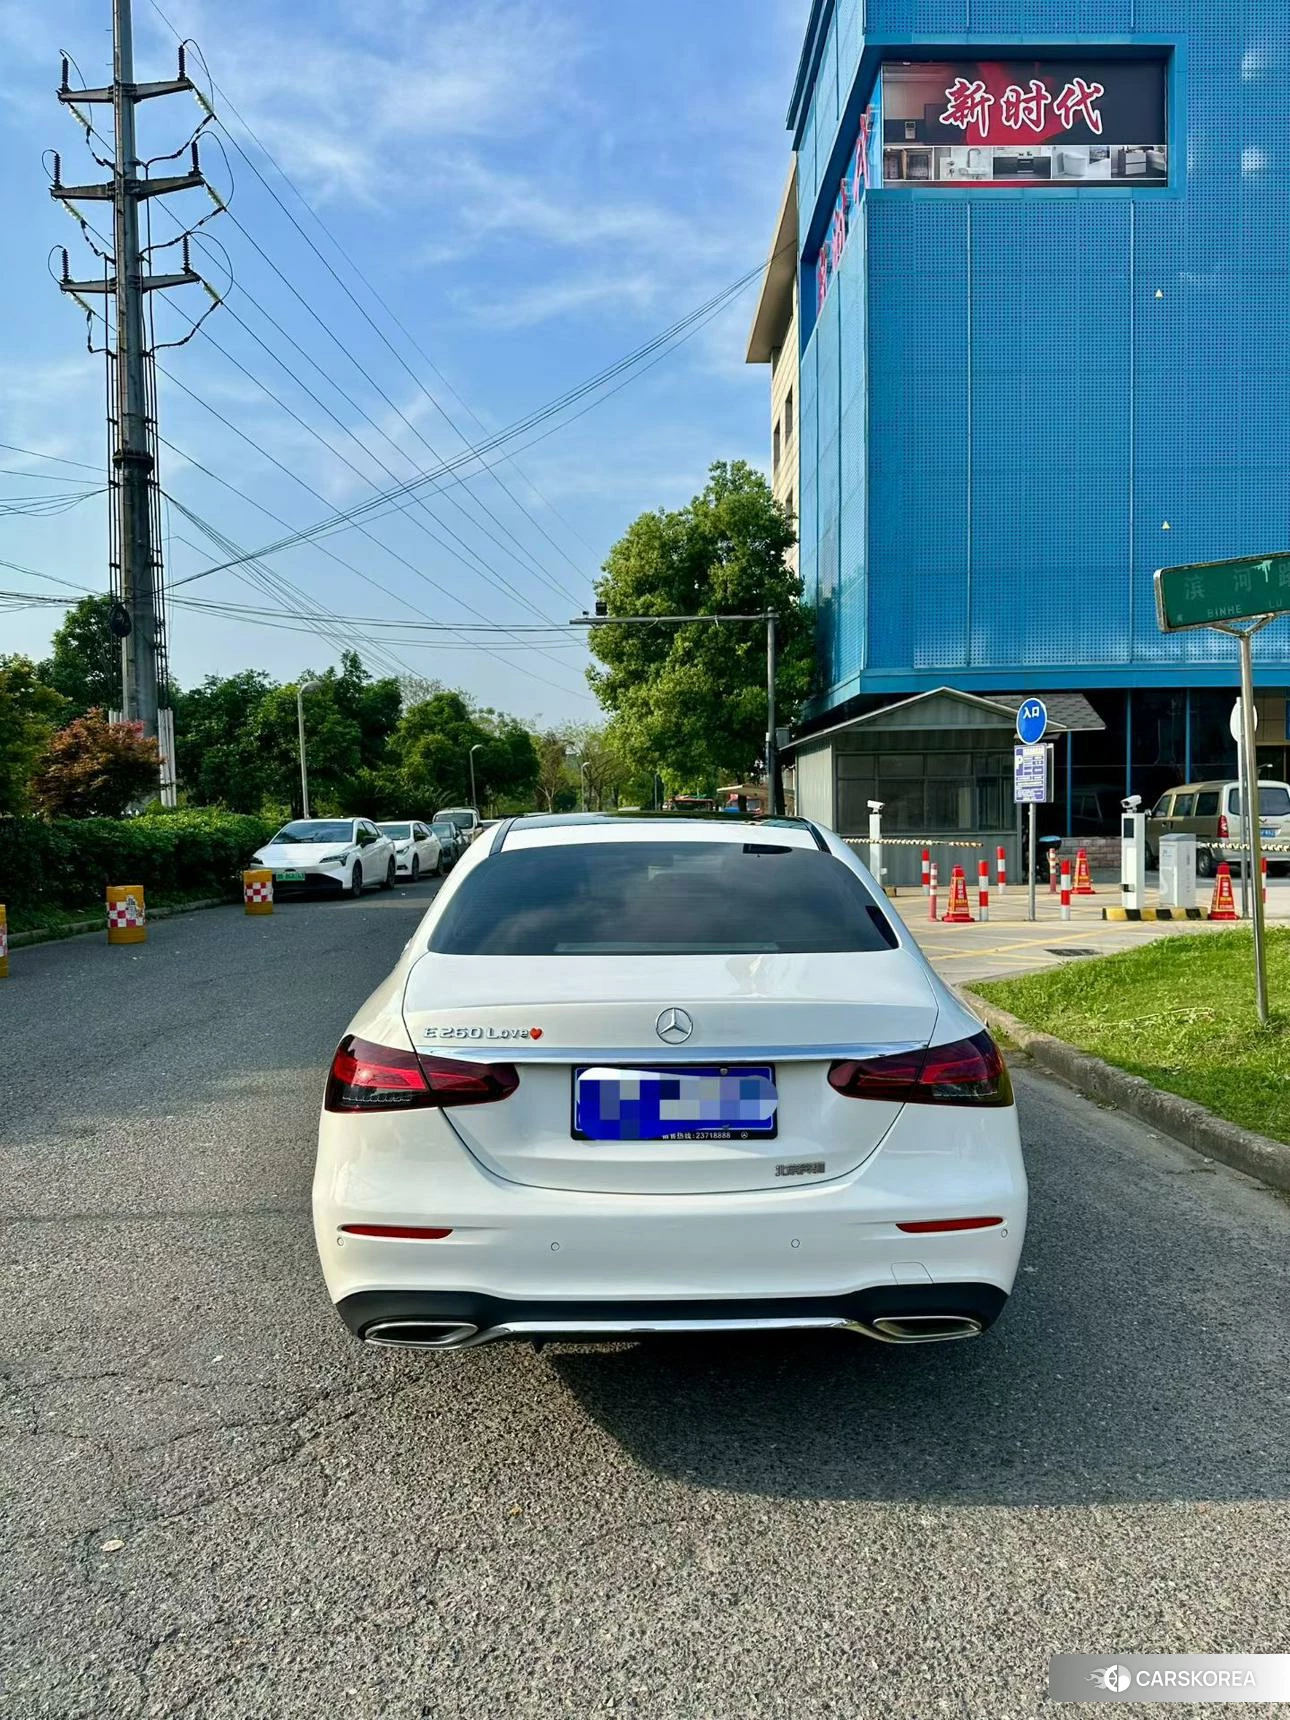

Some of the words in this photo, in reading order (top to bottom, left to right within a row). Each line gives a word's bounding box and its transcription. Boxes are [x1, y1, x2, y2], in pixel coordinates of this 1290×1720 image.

[939, 77, 1105, 138] 新时代
[1207, 604, 1242, 618] BINHE
[1022, 706, 1040, 719] 入口
[486, 1027, 530, 1040] Love
